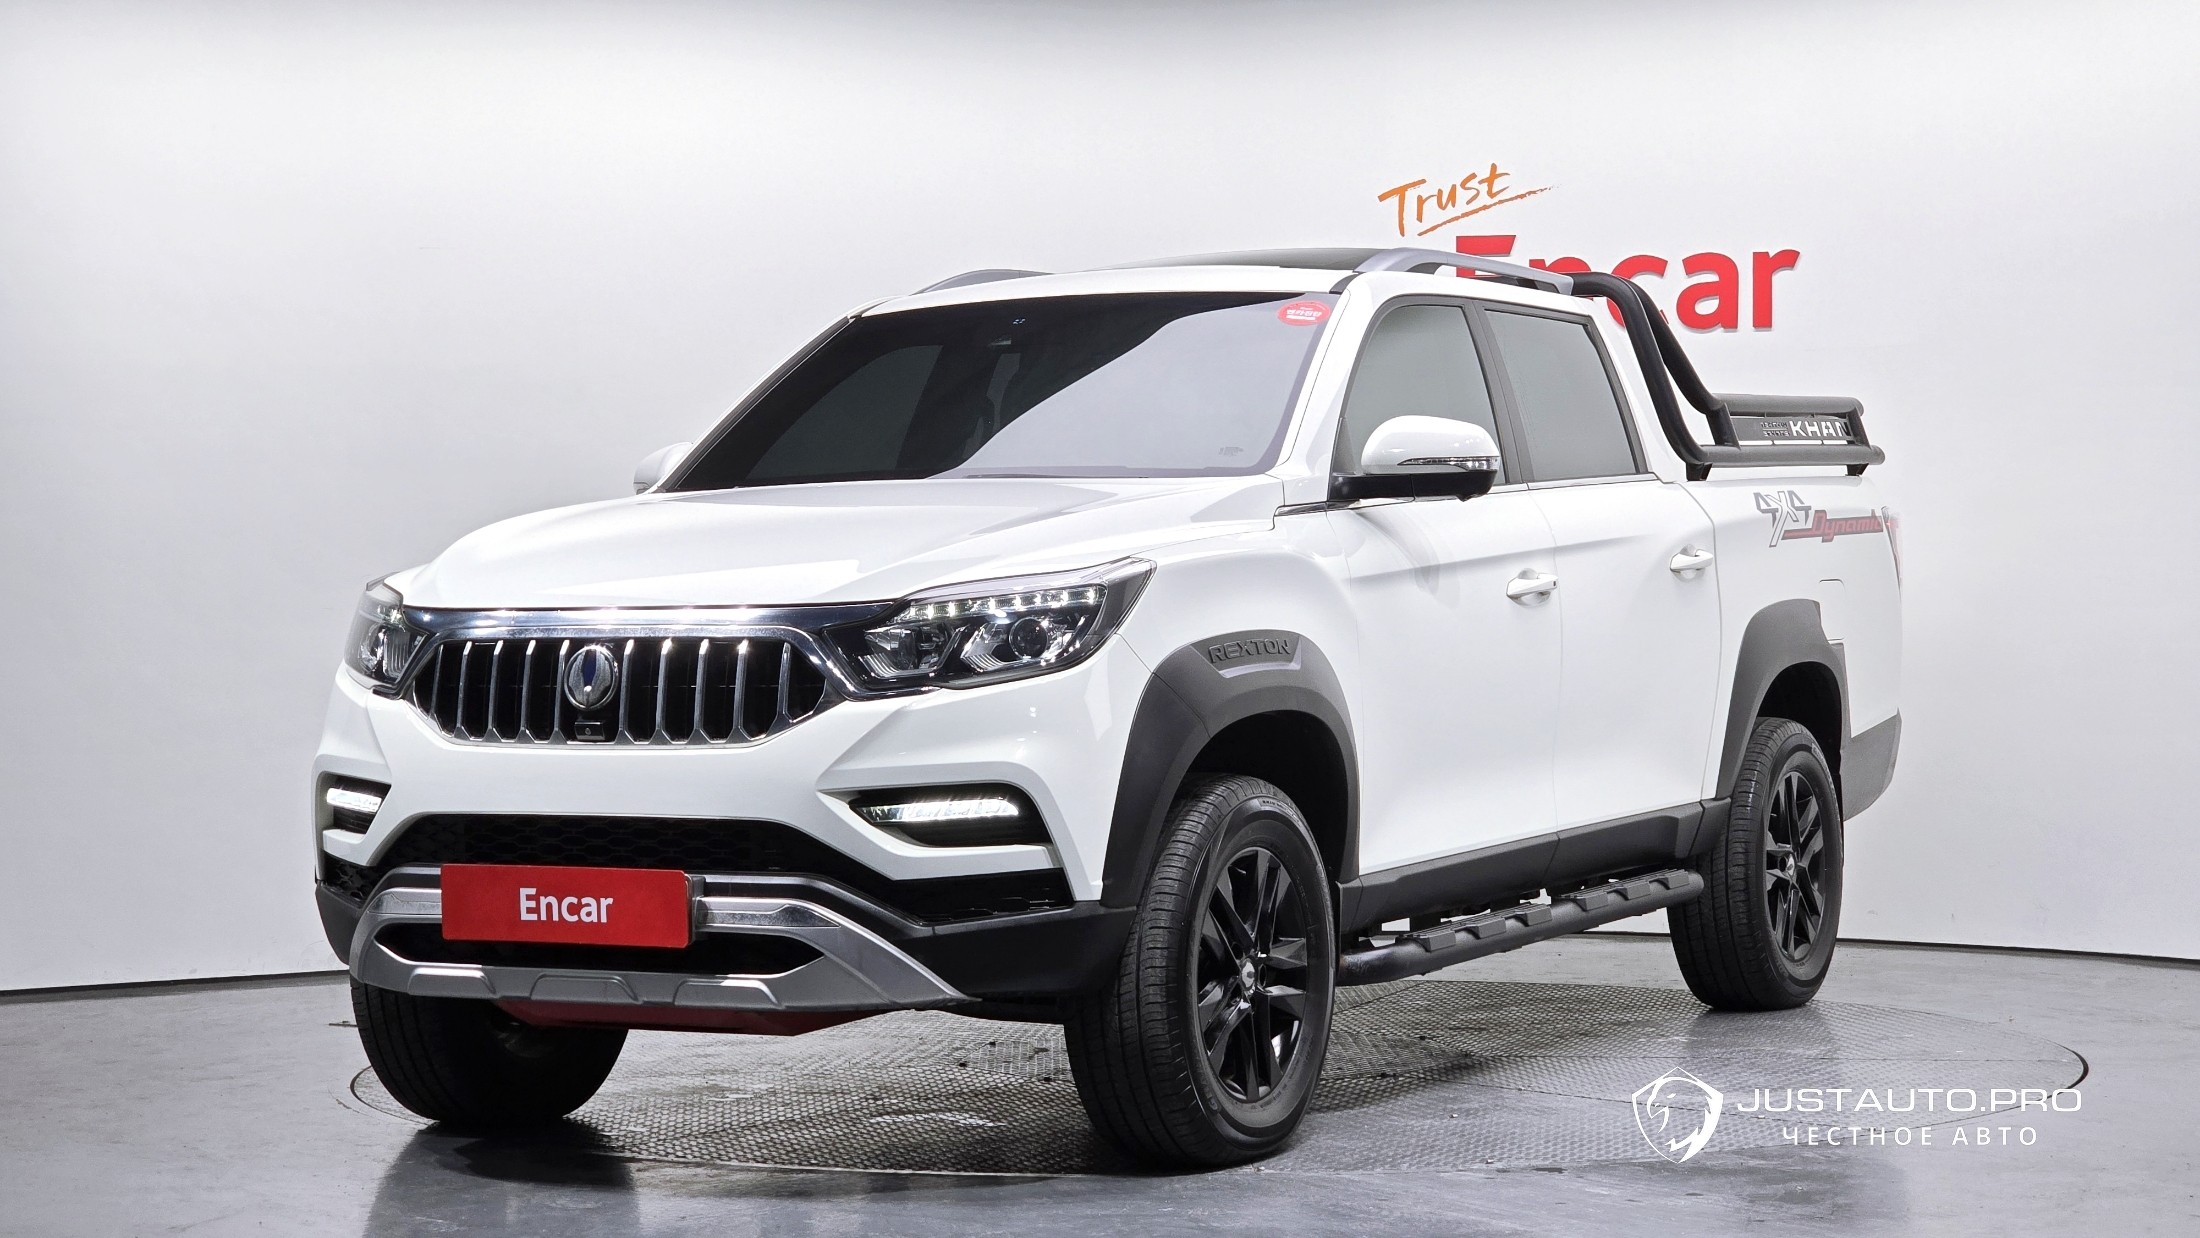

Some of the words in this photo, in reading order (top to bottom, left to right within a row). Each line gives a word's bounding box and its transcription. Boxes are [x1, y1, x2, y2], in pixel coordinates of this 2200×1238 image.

[1378, 163, 1511, 237] Trust
[1789, 420, 1852, 437] KHAN
[1207, 638, 1291, 664] REXTON
[519, 887, 614, 923] Encar
